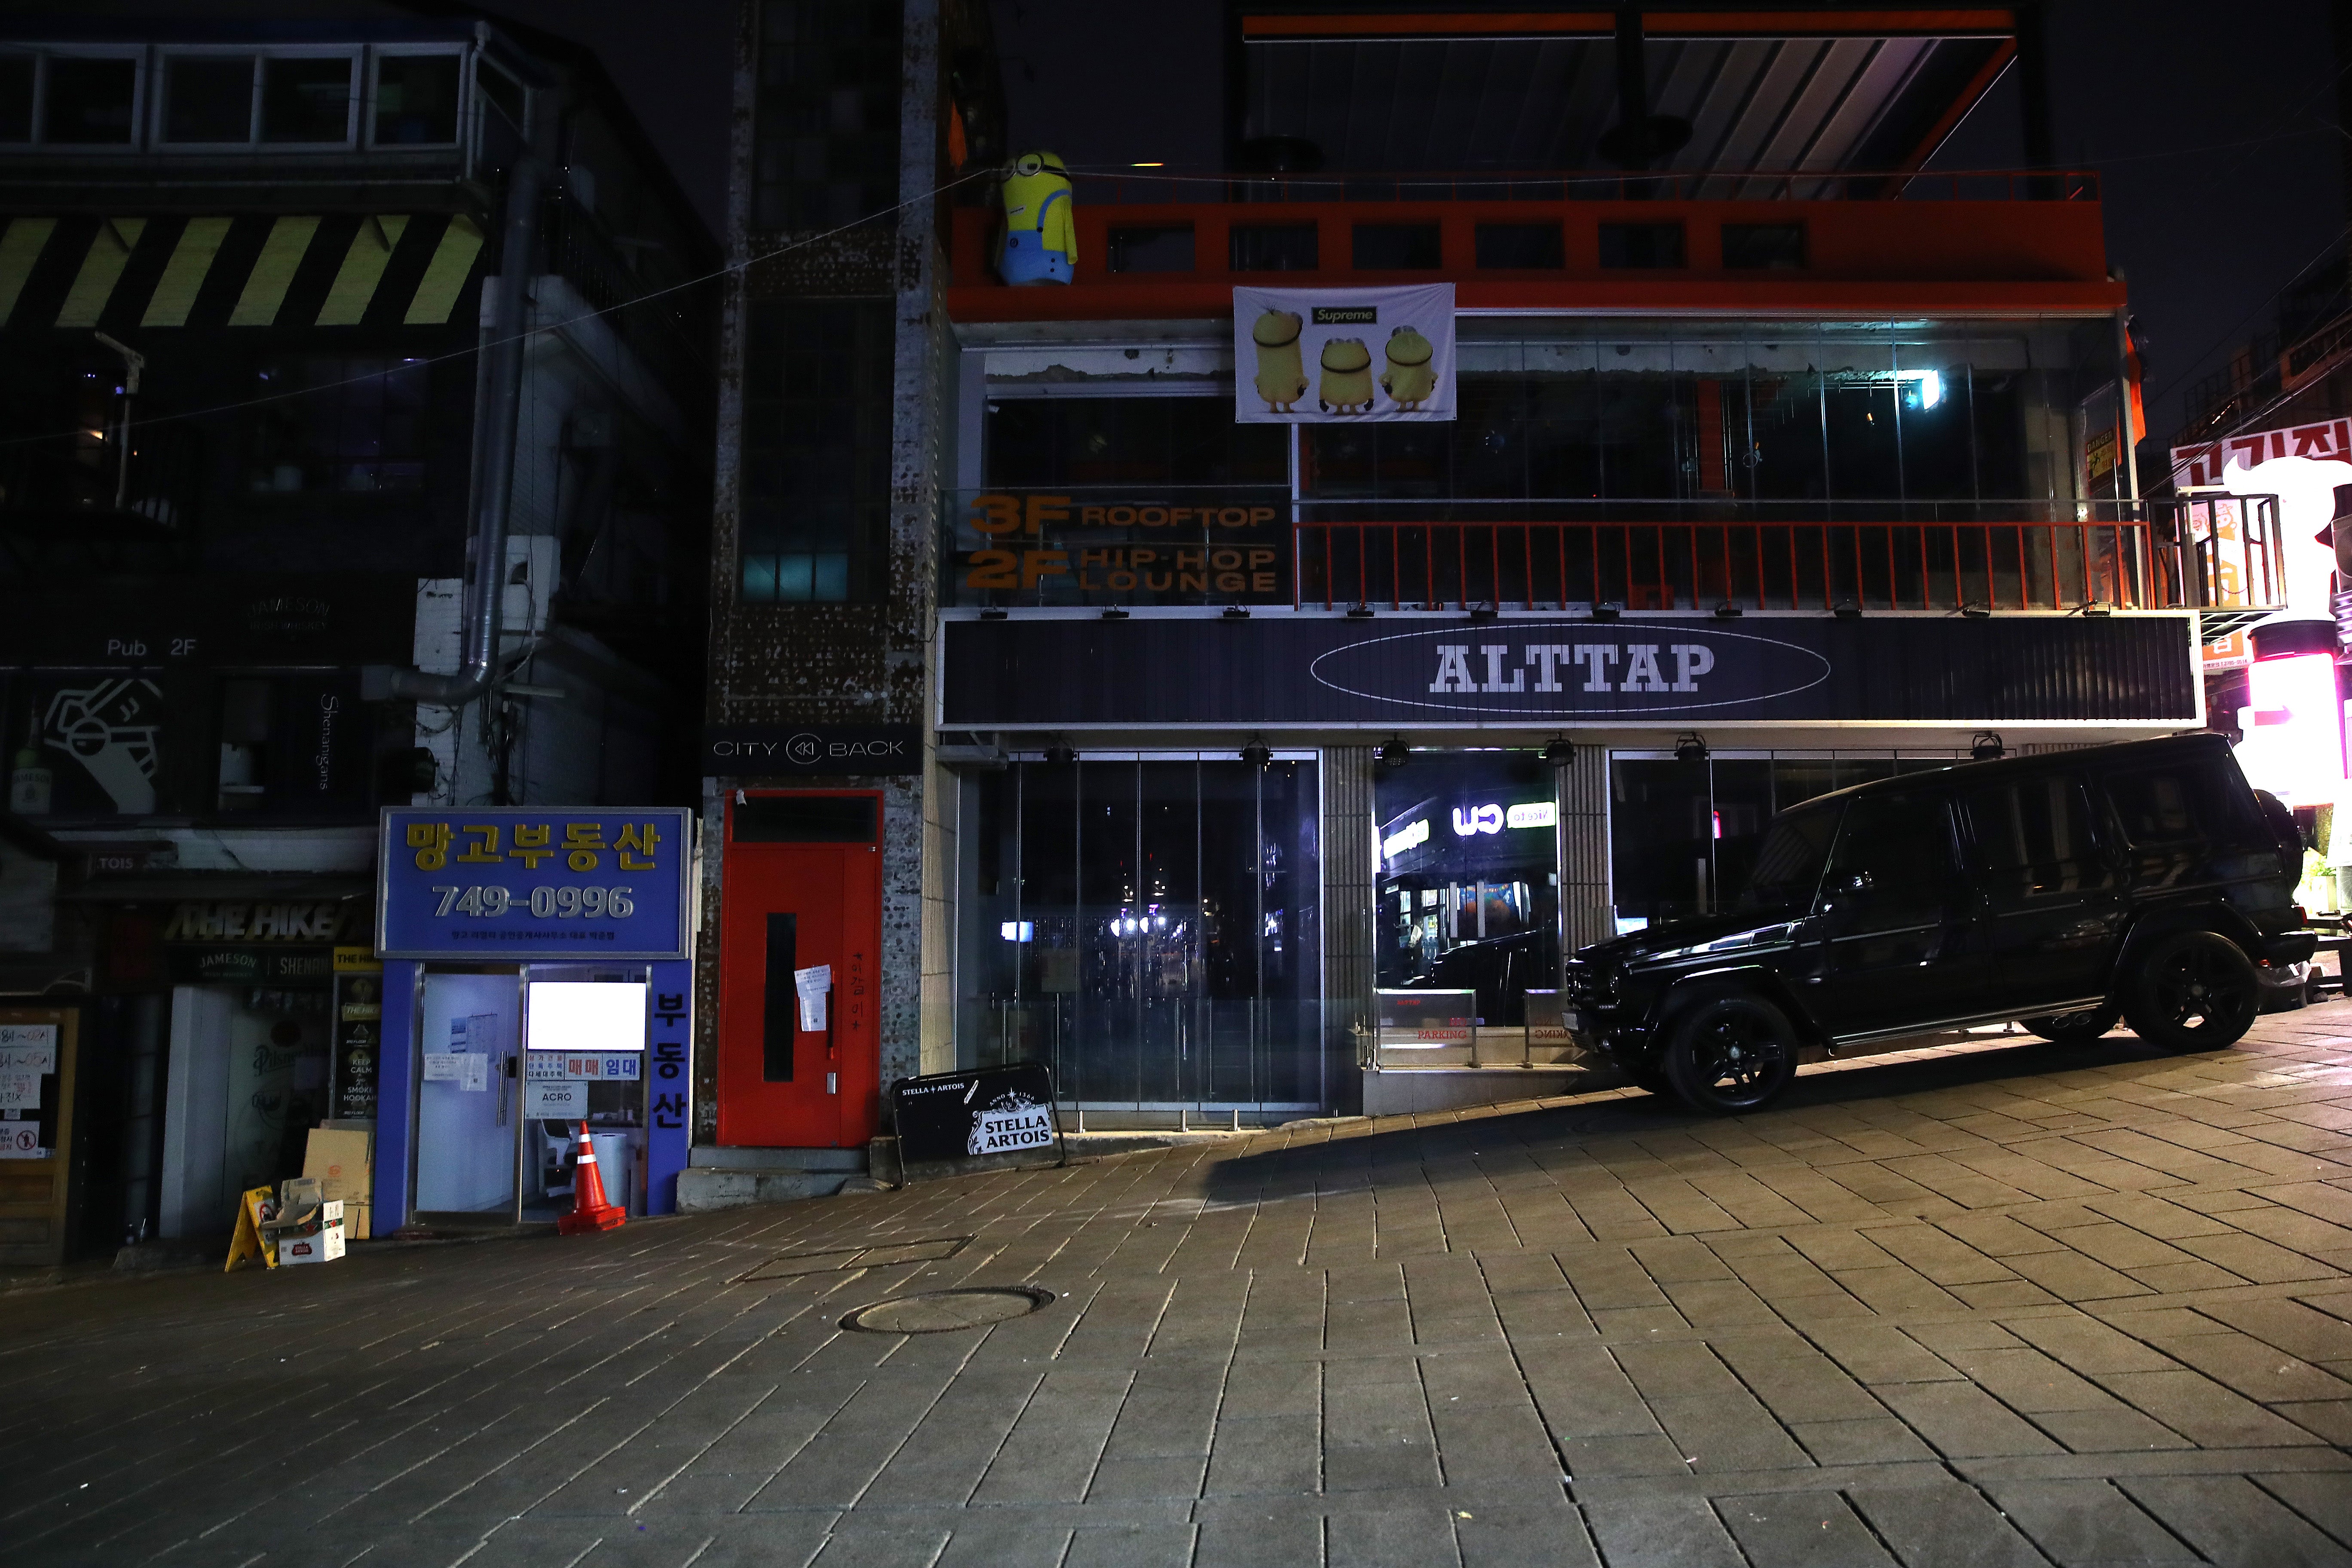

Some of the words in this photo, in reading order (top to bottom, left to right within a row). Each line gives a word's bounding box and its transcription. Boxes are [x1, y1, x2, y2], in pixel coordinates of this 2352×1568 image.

[1317, 309, 1373, 323] Supreme
[2087, 430, 2113, 453] DANGER
[969, 494, 1072, 535] 3F
[1081, 506, 1276, 527] ROOFTOP
[966, 550, 1068, 589] 2F
[1079, 570, 1277, 592] LOUNGE
[248, 597, 330, 617] JAMESON
[107, 638, 147, 656] Pub
[171, 638, 197, 656] 2F
[1430, 643, 1715, 693] ALTTAP
[319, 693, 339, 791] Shenanigans
[714, 741, 778, 756] CITY
[829, 740, 904, 756] BACK
[406, 823, 661, 872] 망고부동산
[432, 885, 634, 919] 749-0996
[247, 902, 340, 940] HIKE
[199, 952, 257, 969] JAMESON
[337, 954, 357, 963] THE
[1449, 1017, 1466, 1027] NO
[1418, 1030, 1467, 1039] PARKING
[568, 1059, 599, 1075] 매매
[606, 1059, 637, 1075] 임대
[653, 993, 687, 1129] 부동산
[542, 1093, 572, 1101] ACRO
[902, 1087, 929, 1096] STELLA
[937, 1082, 965, 1092] ARTOIS
[989, 1093, 1006, 1106] ANNO
[1019, 1091, 1035, 1101] 1366
[985, 1115, 1048, 1134] STELLA
[986, 1129, 1050, 1148] ARTOIS
